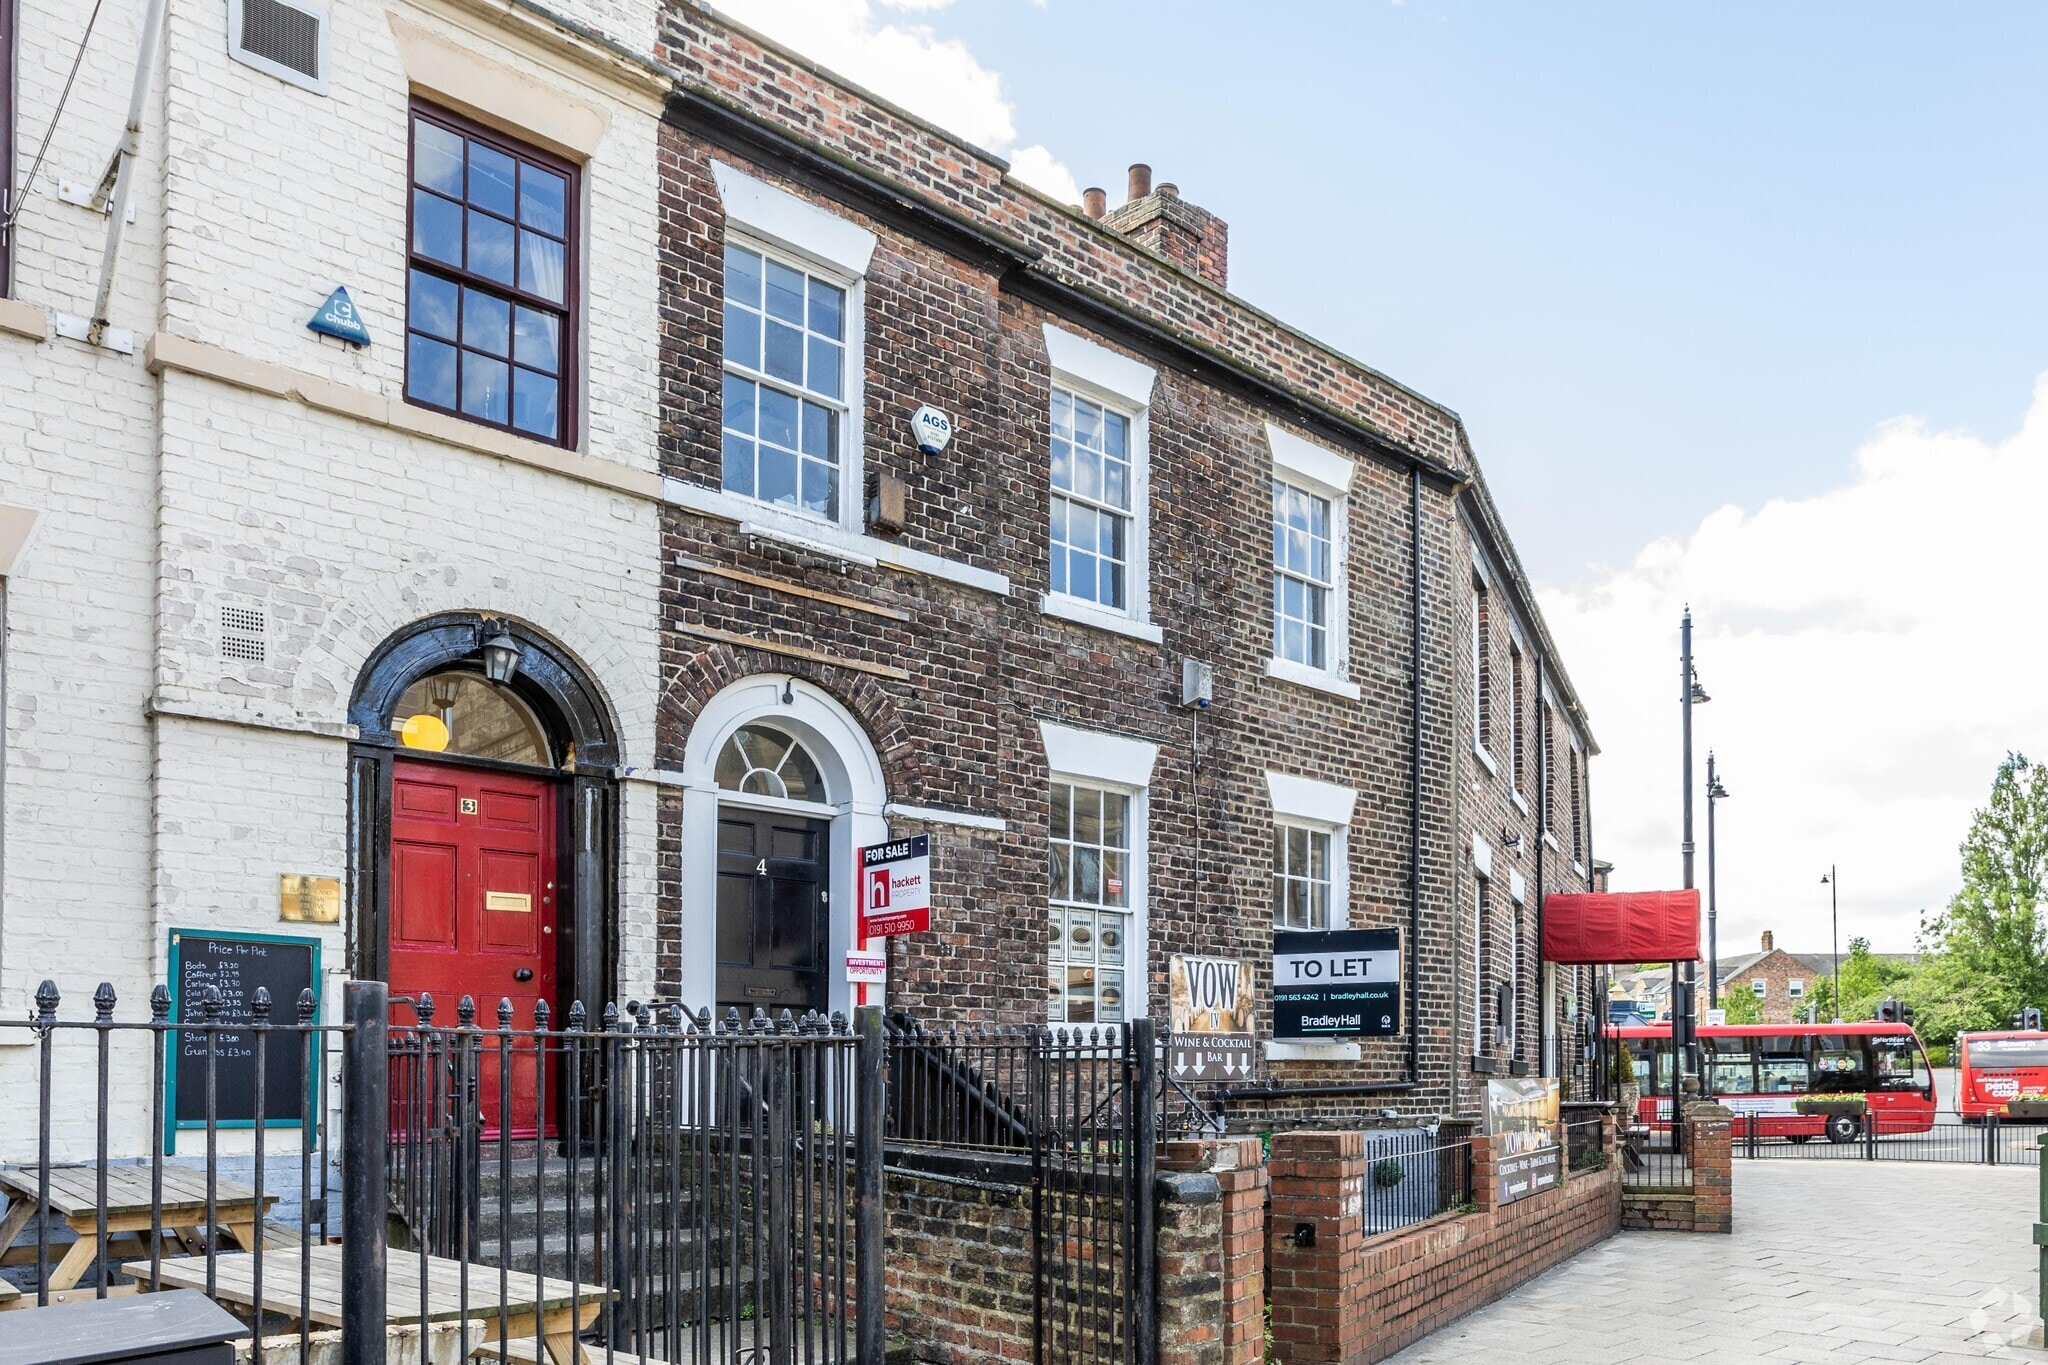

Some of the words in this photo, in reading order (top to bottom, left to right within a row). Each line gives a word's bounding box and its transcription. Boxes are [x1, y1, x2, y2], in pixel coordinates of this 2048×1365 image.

[325, 312, 361, 331] Chubb
[923, 413, 948, 431] AGS
[463, 800, 474, 813] 3
[865, 847, 885, 863] FOR
[885, 842, 909, 859] SALE
[756, 859, 767, 876] 4
[891, 874, 921, 889] hackett
[891, 887, 921, 899] PROPERTY
[869, 924, 883, 935] 0191
[884, 922, 896, 933] 510
[897, 920, 915, 931] 9950
[209, 942, 233, 955] Price
[236, 945, 249, 954] Per
[251, 946, 268, 956] Pint
[849, 958, 885, 967] INVESTMENT
[1290, 960, 1322, 978] TO
[1330, 958, 1372, 977] LET
[849, 967, 883, 976] OPPORTUNITY
[1185, 961, 1238, 1009] VOW
[1274, 994, 1287, 1002] 0191
[1302, 993, 1319, 1001] 4242
[1330, 991, 1389, 1001] bradleyhall.co.uk
[185, 1009, 203, 1017] John
[1174, 1036, 1201, 1047] WINE
[1203, 1037, 1210, 1047] &
[1211, 1037, 1252, 1049] COCKTAIL
[1976, 1041, 1991, 1051] 33
[185, 1045, 224, 1056] Guinss
[1207, 1052, 1223, 1062] BAR
[1985, 1081, 2019, 1092] pencil
[1504, 1131, 1521, 1154] VOW
